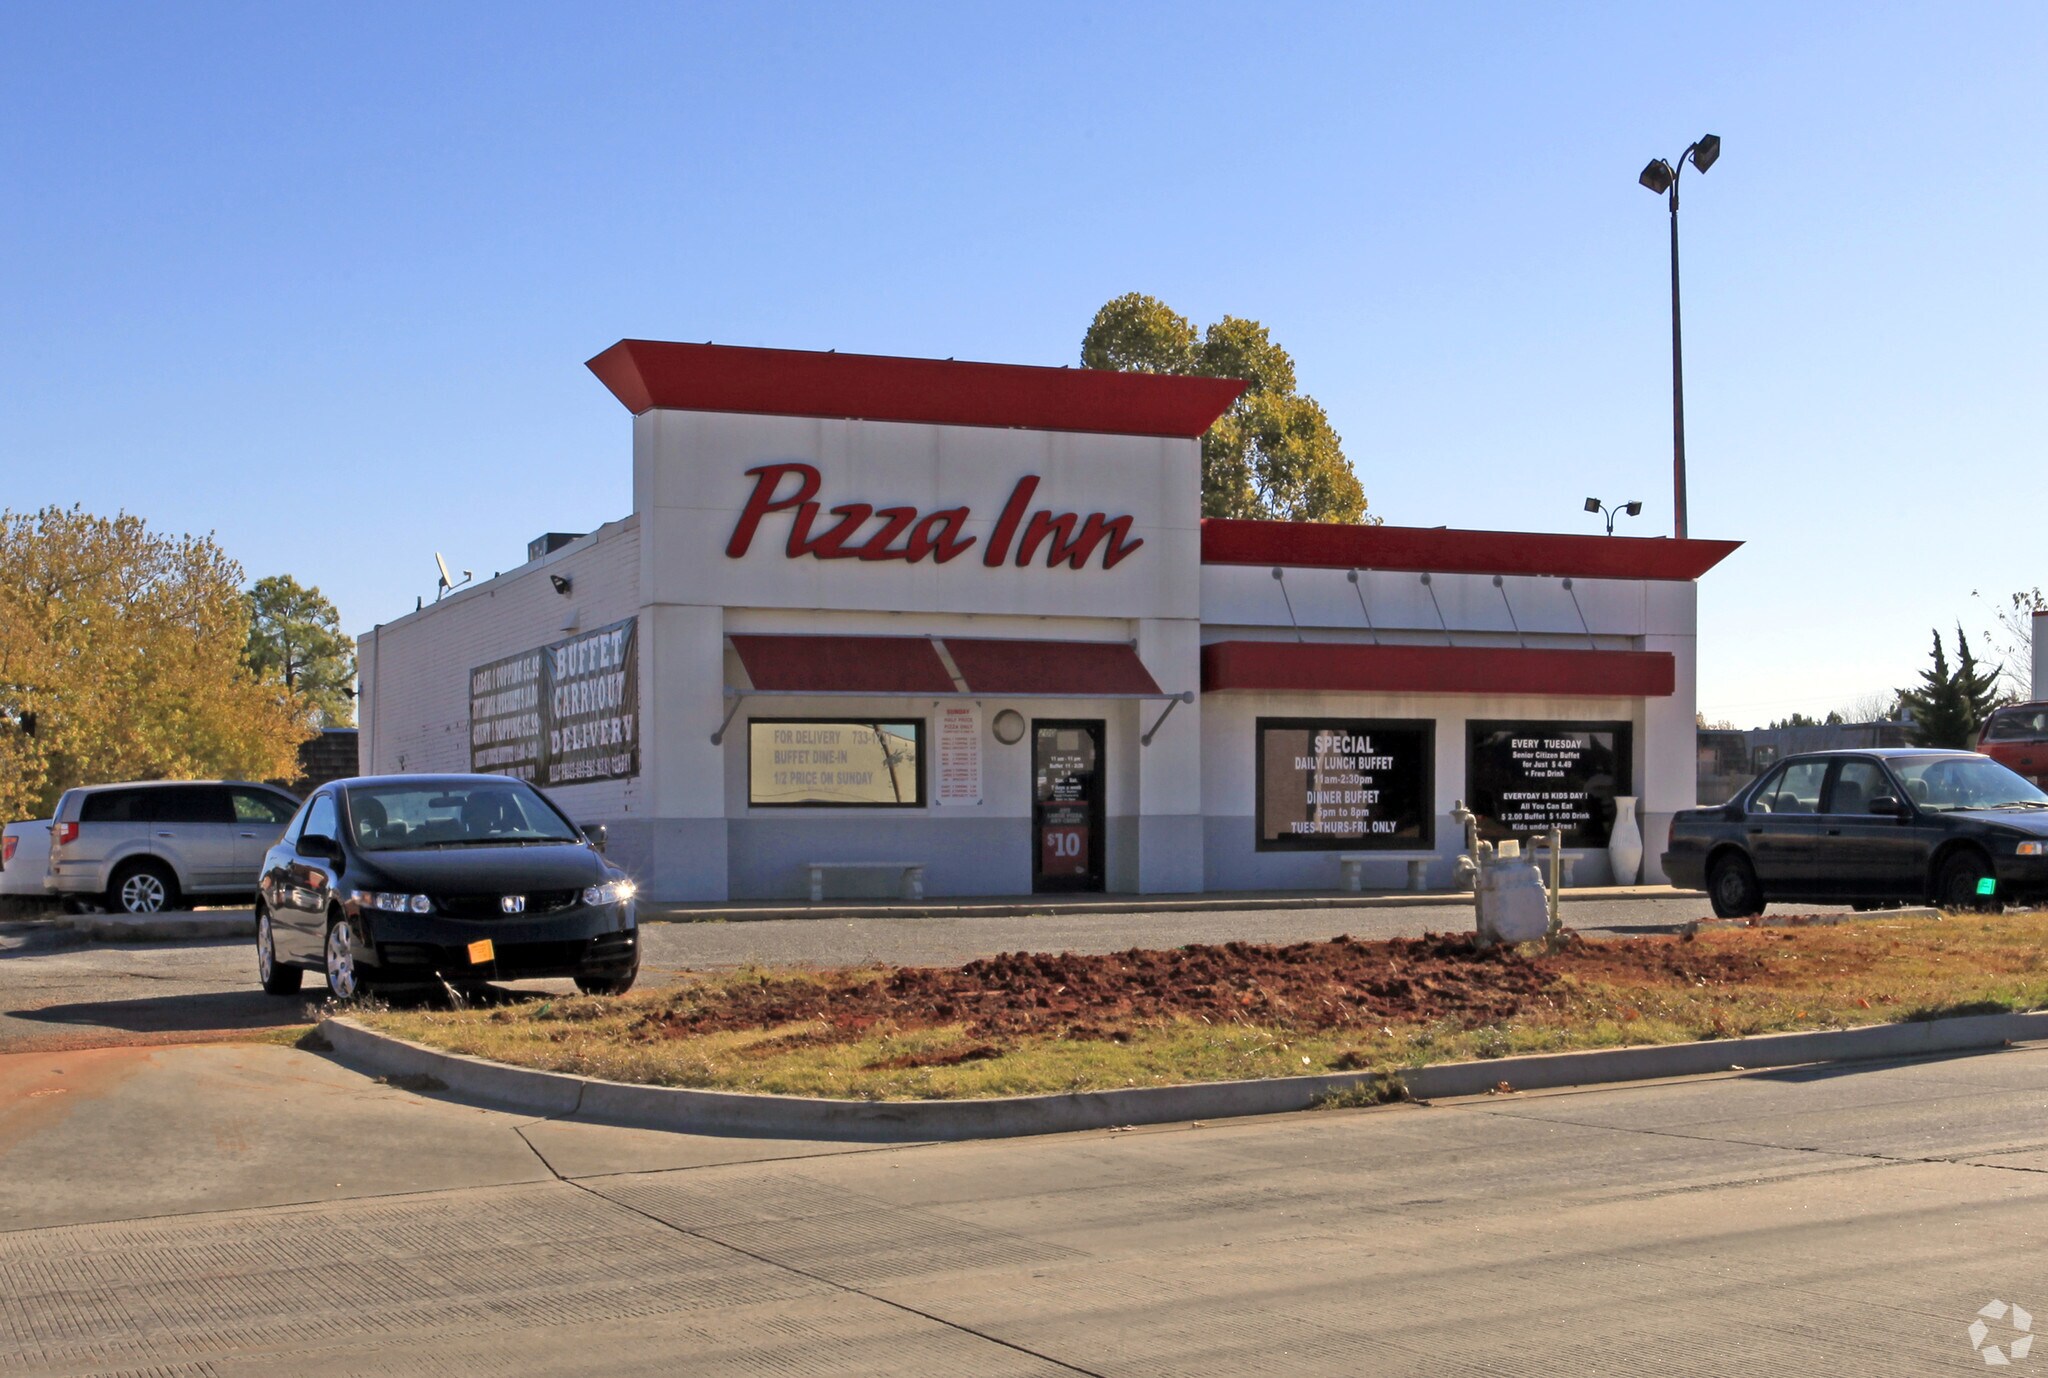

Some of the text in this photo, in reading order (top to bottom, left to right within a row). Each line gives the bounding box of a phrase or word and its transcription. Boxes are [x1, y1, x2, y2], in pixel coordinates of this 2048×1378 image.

[725, 463, 1144, 570] Pizza Inn
[556, 630, 623, 681] BUFFET
[554, 671, 625, 719] CARRYOUT
[551, 714, 633, 755] DELIVERY
[774, 730, 793, 745] FOR
[796, 730, 841, 745] DELIVERY
[1314, 736, 1374, 753] SPECIAL
[1512, 739, 1582, 748] EVERY TUESDAY
[774, 750, 847, 765] BUFFET DINE-IN
[1295, 756, 1394, 770] DAILY LUNCH BUFFET
[774, 771, 873, 785] 1/2 PRICE ON SUNDAY
[1314, 774, 1373, 786] 11am-2:30pm
[1306, 790, 1380, 804] DINNER BUFFET
[1318, 806, 1370, 818] 5pm to 8pm
[1372, 821, 1396, 833] ONLY
[1048, 832, 1080, 857] $10
